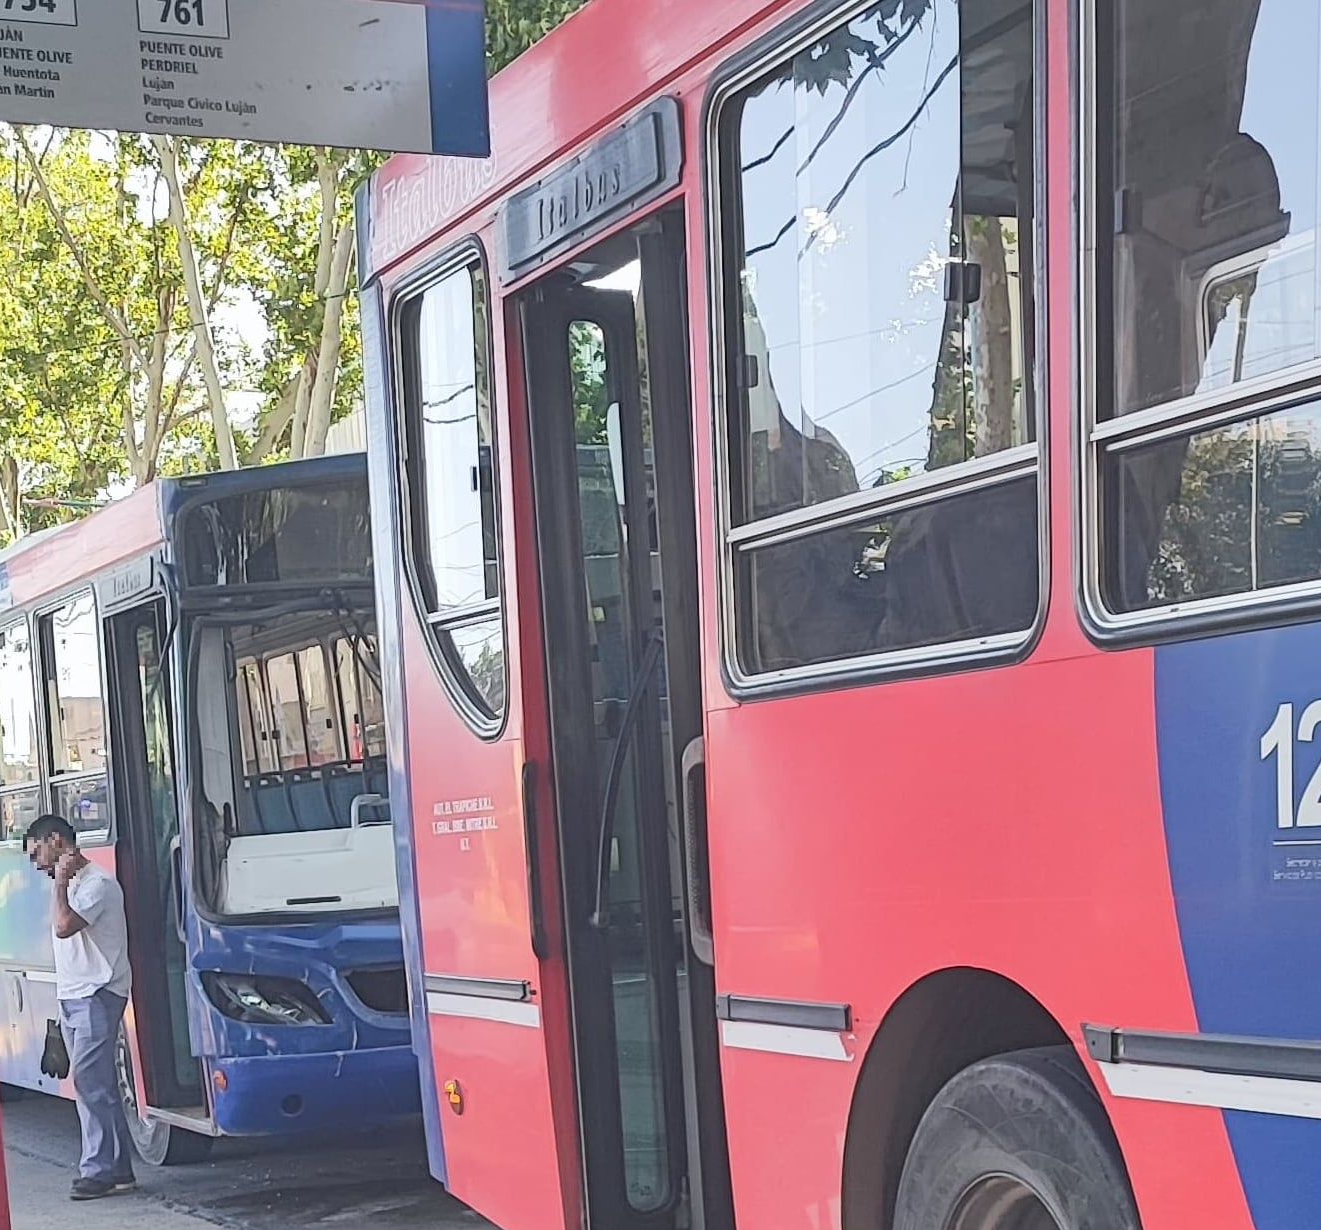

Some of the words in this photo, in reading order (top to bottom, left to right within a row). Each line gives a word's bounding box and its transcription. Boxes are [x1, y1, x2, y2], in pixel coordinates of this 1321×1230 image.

[158, 0, 204, 26] 761
[36, 50, 73, 64] OLIVE
[139, 40, 186, 56] PUENTE
[189, 45, 223, 59] OLIVE
[3, 65, 61, 81] Huentota
[141, 58, 199, 74] PERDRIEL
[143, 93, 185, 110] Parque
[145, 112, 204, 127] Cervantes
